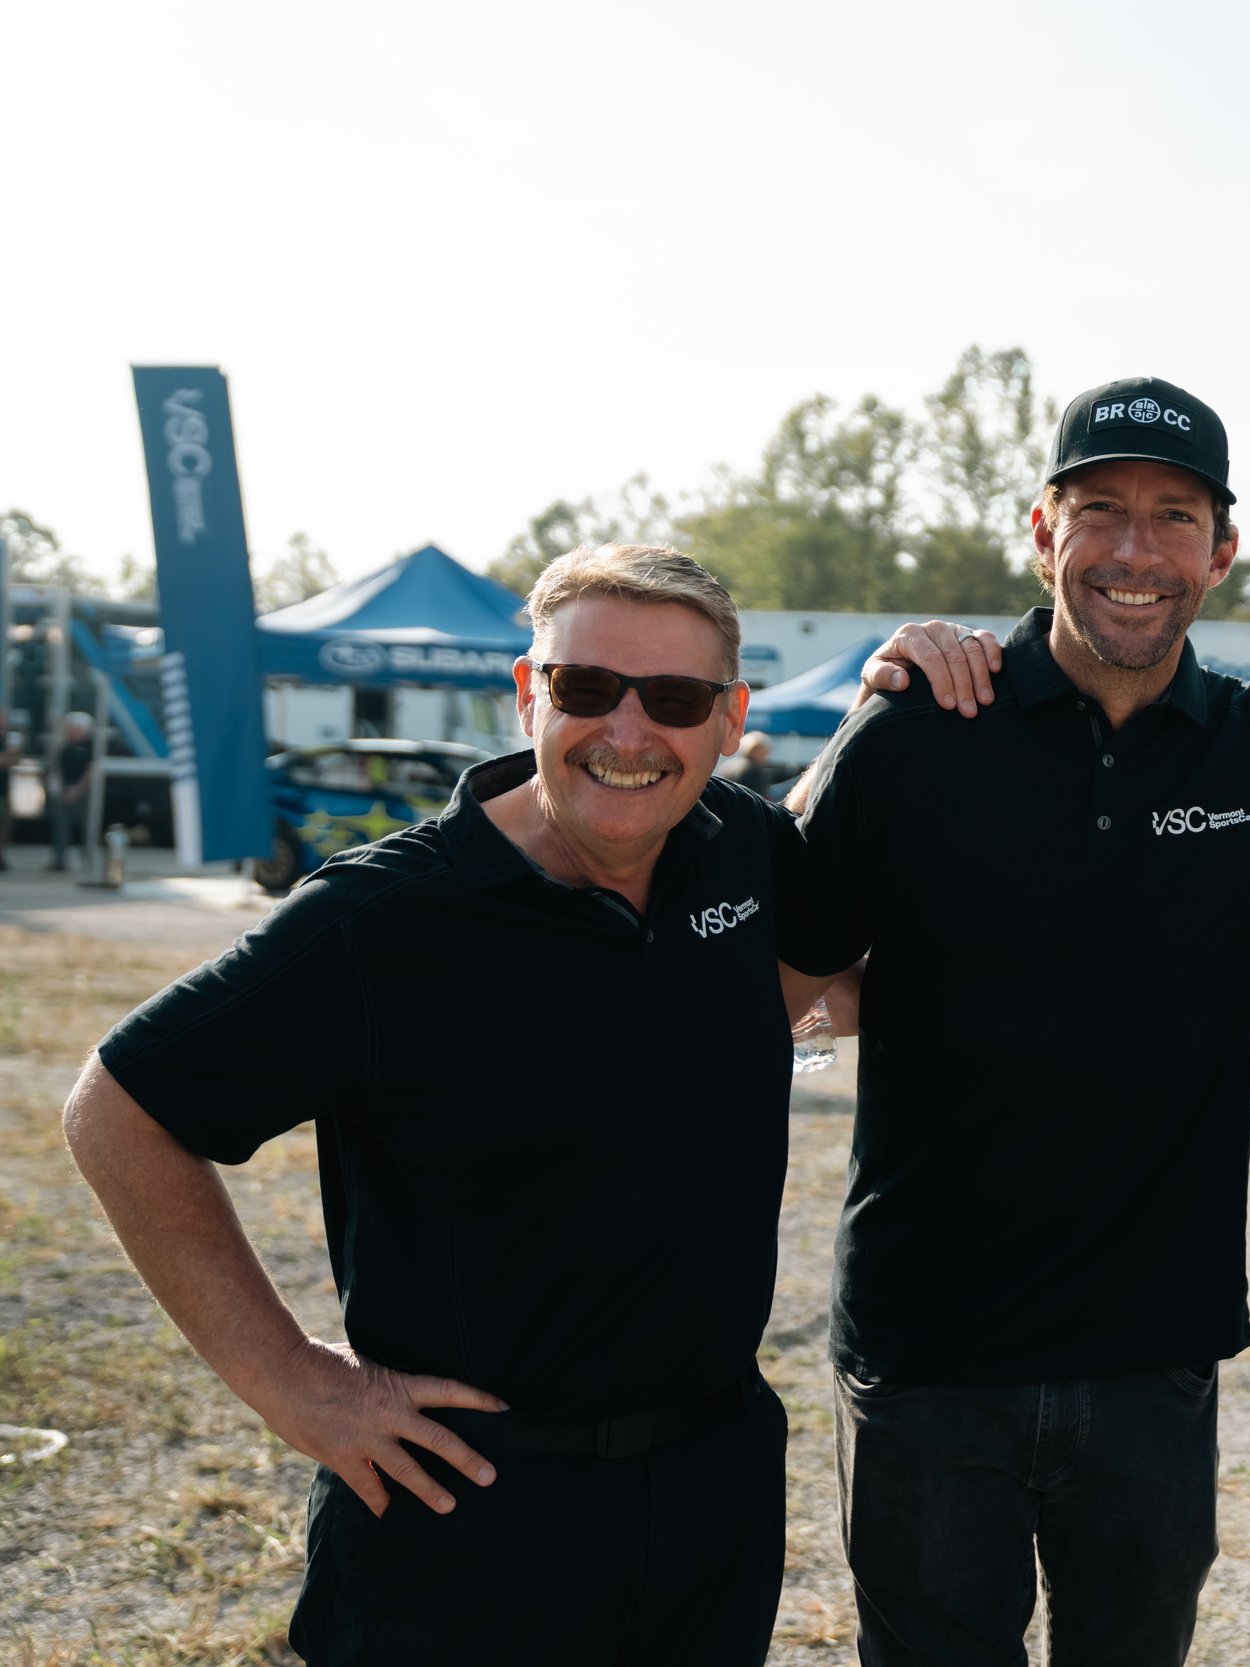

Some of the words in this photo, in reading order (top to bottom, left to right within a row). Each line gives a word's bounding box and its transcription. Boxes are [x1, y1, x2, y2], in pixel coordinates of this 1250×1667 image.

[1094, 403, 1126, 423] BR
[1163, 408, 1191, 431] CC
[1152, 806, 1207, 836] VSC
[1207, 808, 1245, 822] Vermont
[733, 896, 755, 914] Vermont
[690, 901, 737, 938] VSC
